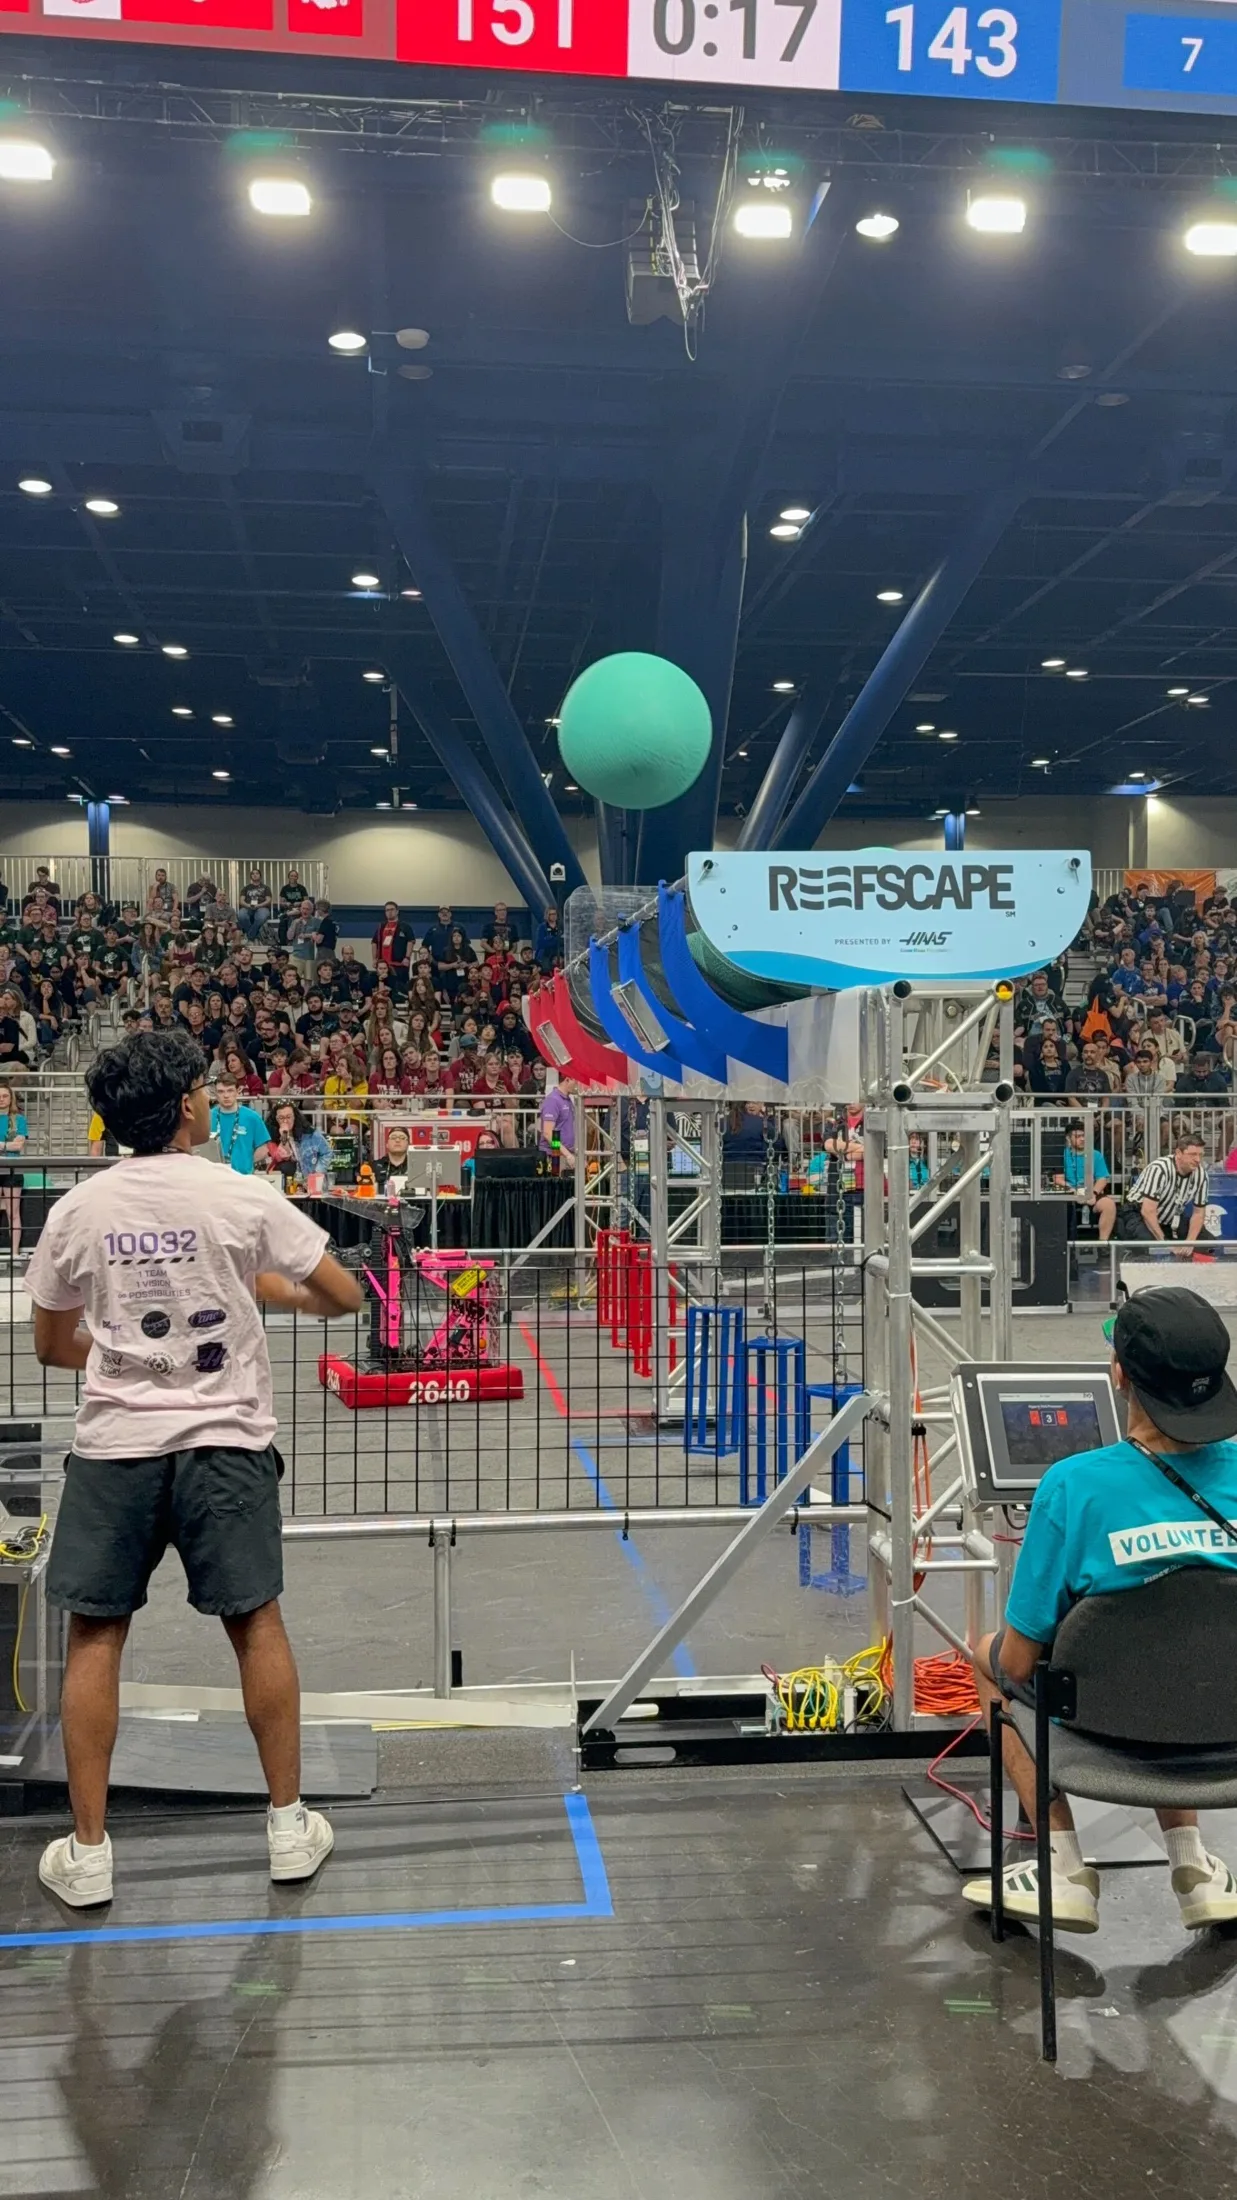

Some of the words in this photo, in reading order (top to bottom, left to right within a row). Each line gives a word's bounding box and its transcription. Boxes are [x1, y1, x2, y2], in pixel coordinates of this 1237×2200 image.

[457, 0, 573, 49] 151
[652, 0, 818, 63] 0:17
[885, 3, 1019, 79] 143
[1181, 37, 1204, 73] 7
[768, 864, 1015, 911] REEFSCAPE
[834, 938, 879, 946] PRESENTED
[881, 938, 891, 946] BY
[899, 931, 953, 946] HAAS
[104, 1229, 198, 1256] 10032
[142, 1279, 171, 1288] VISION
[145, 1269, 168, 1277] TEAM
[129, 1288, 191, 1299] POSSIBILITIES
[407, 1379, 470, 1404] 2640
[1046, 1414, 1053, 1423] 3
